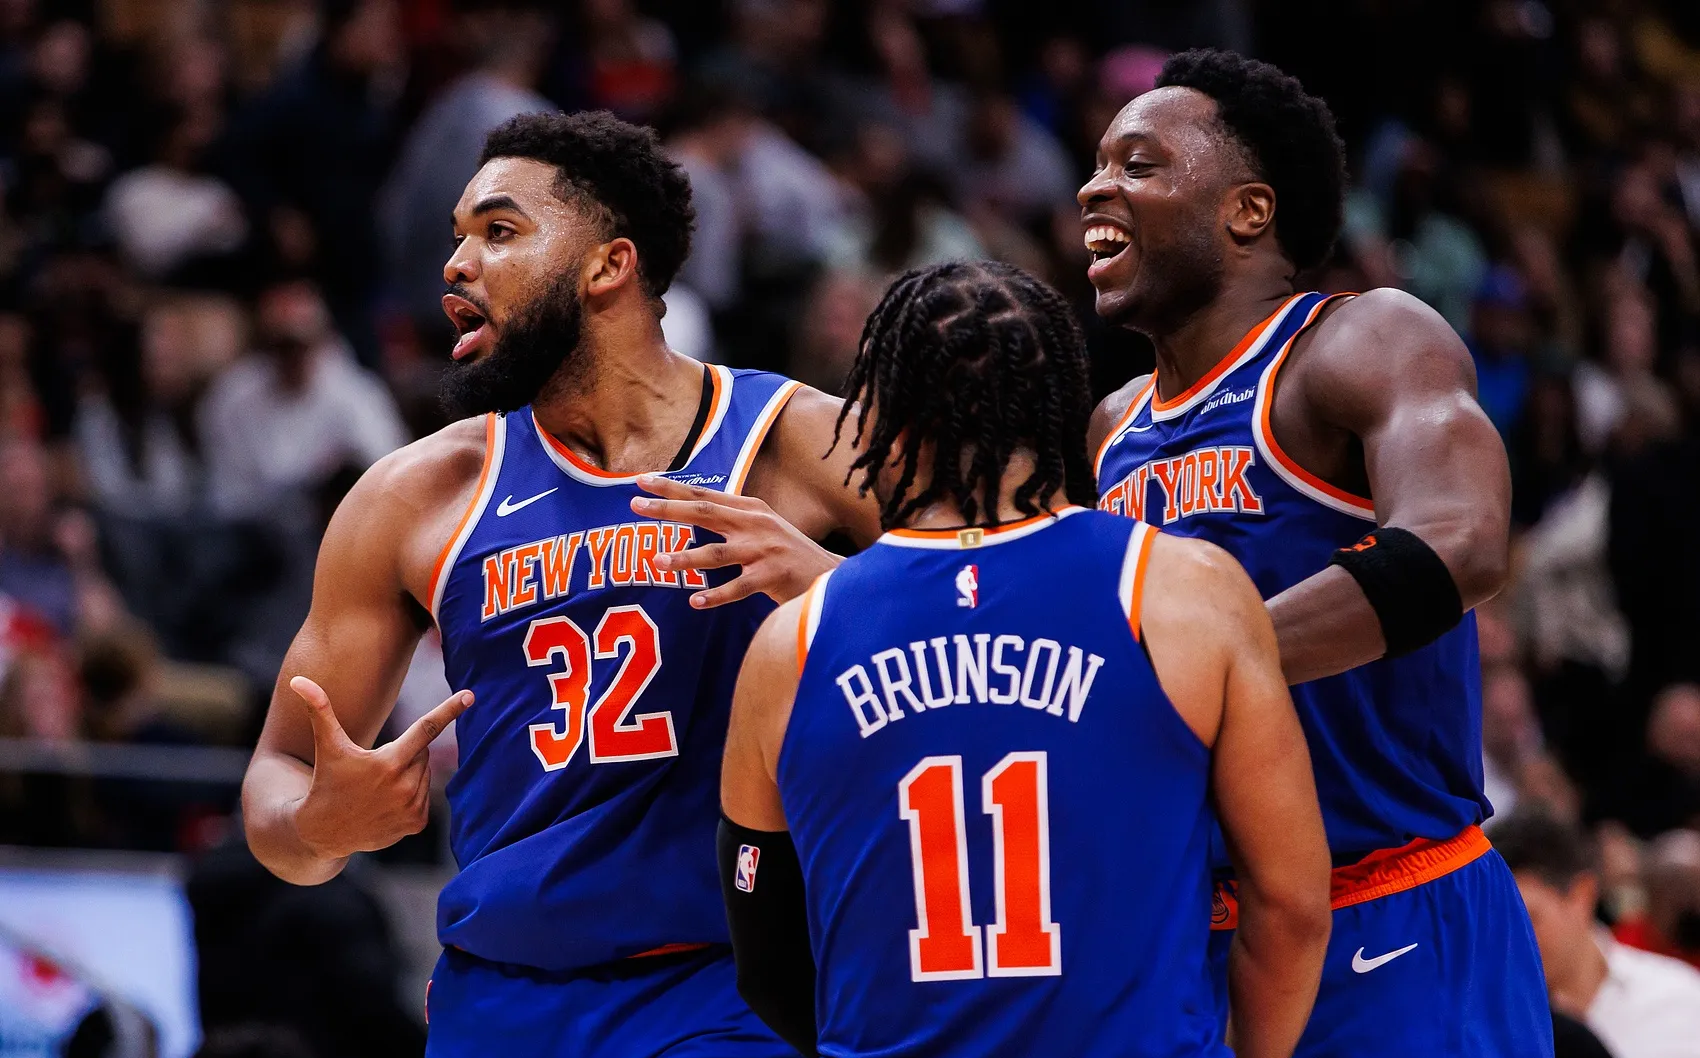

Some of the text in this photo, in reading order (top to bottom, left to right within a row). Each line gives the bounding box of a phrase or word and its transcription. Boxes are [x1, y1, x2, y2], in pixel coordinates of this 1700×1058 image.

[1200, 399, 1219, 415] abu
[1219, 385, 1256, 406] dhabi
[1150, 446, 1265, 526] YORK
[480, 521, 709, 623] NEW YORK
[522, 603, 679, 772] 32
[835, 633, 1105, 739] BRUNSON
[898, 751, 1062, 983] 11
